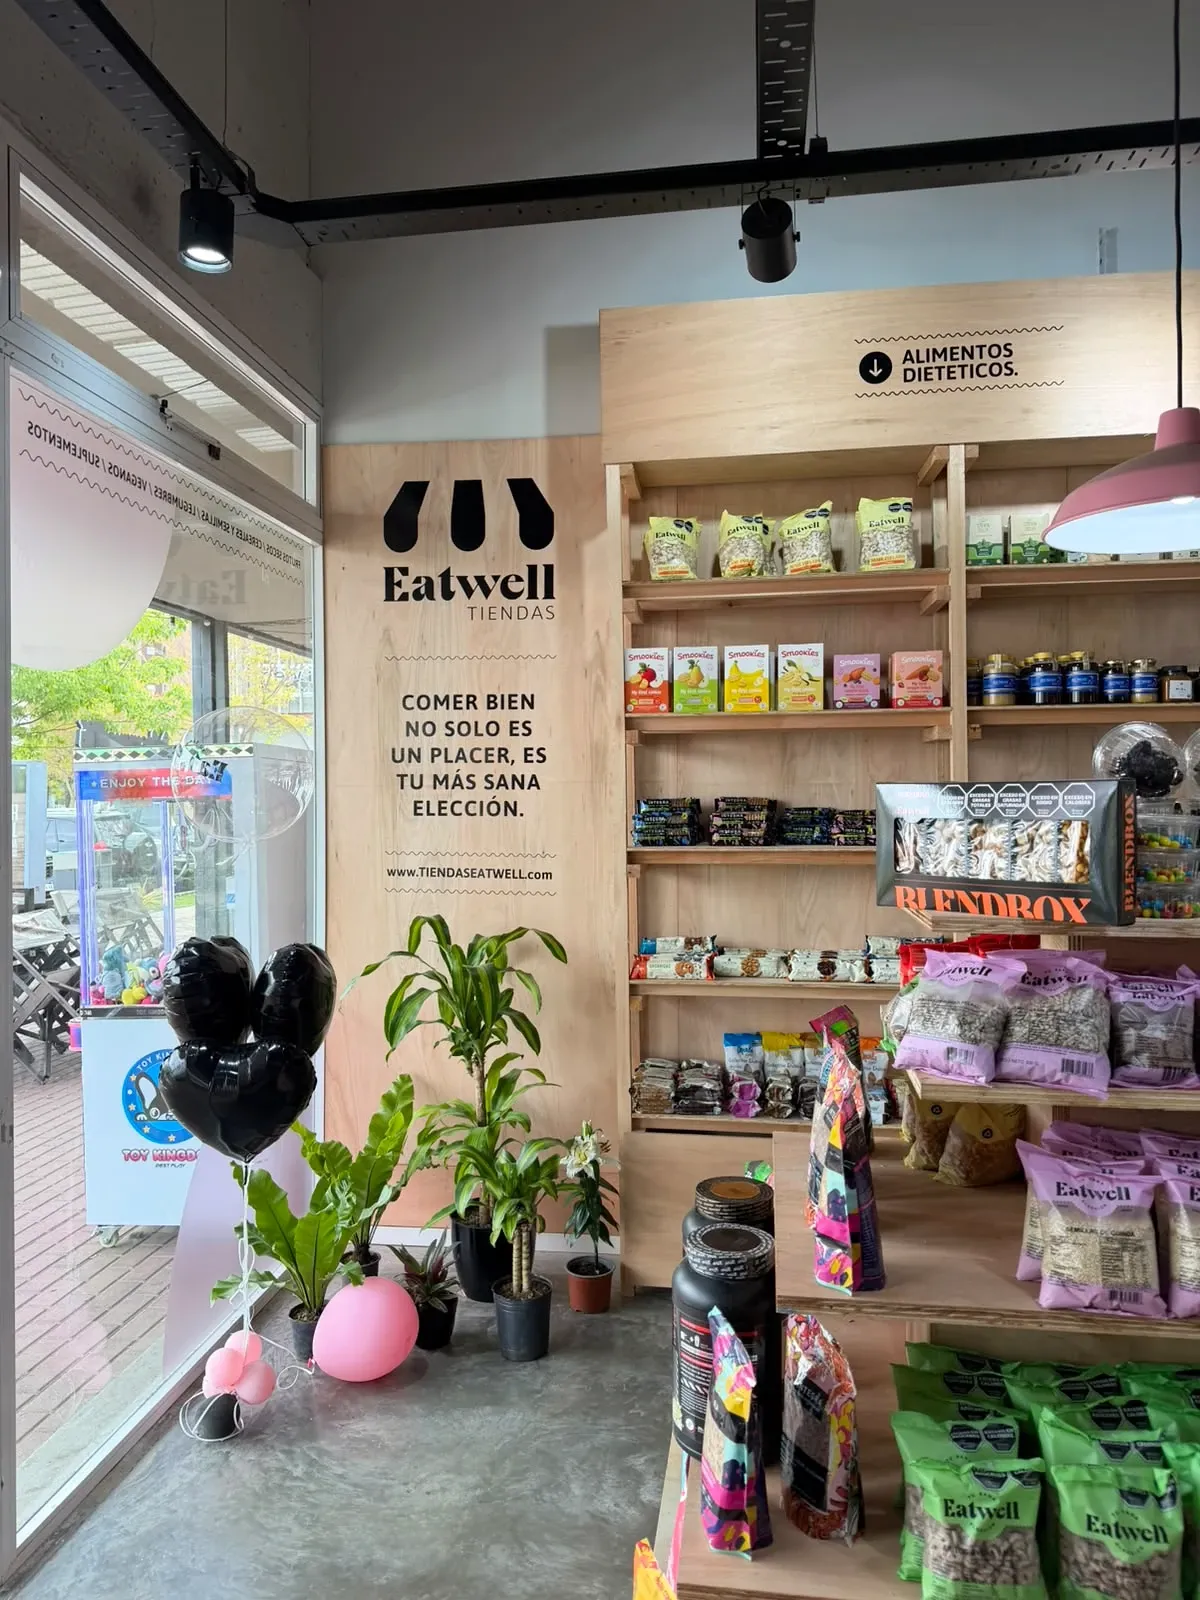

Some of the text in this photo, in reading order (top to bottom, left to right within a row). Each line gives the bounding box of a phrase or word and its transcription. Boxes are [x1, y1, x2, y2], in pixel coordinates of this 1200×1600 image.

[902, 342, 1014, 365] ALIMENTOS
[903, 361, 1019, 383] DIETETICOS.
[787, 521, 820, 536] Eatwell
[869, 516, 905, 528] Eatwell
[655, 531, 686, 541] Eatwell
[383, 563, 556, 602] Eatwell
[467, 605, 556, 621] TIENDAS
[628, 652, 665, 661] Smookies
[677, 651, 714, 660] Smookies
[728, 649, 766, 659] Smookies
[781, 648, 819, 658] Smookies
[839, 657, 875, 667] Smookies
[402, 693, 535, 711] COMER BIEN
[405, 720, 533, 737] NO SOLO ES
[391, 747, 547, 766] UN PLACER, ES
[100, 777, 147, 789] ENJOY
[151, 776, 180, 786] THE
[396, 768, 541, 790] TU MÁS SANA
[413, 795, 524, 817] ELECCIÓN.
[1124, 793, 1135, 911] BLENDBOX
[386, 866, 553, 881] www.TIENDASEATWELL.com
[136, 1056, 153, 1071] TOY
[121, 1148, 150, 1162] TOY
[1055, 1181, 1132, 1201] Eatwell
[943, 1498, 1020, 1520] Eatwell
[1086, 1513, 1170, 1545] Eatwell
